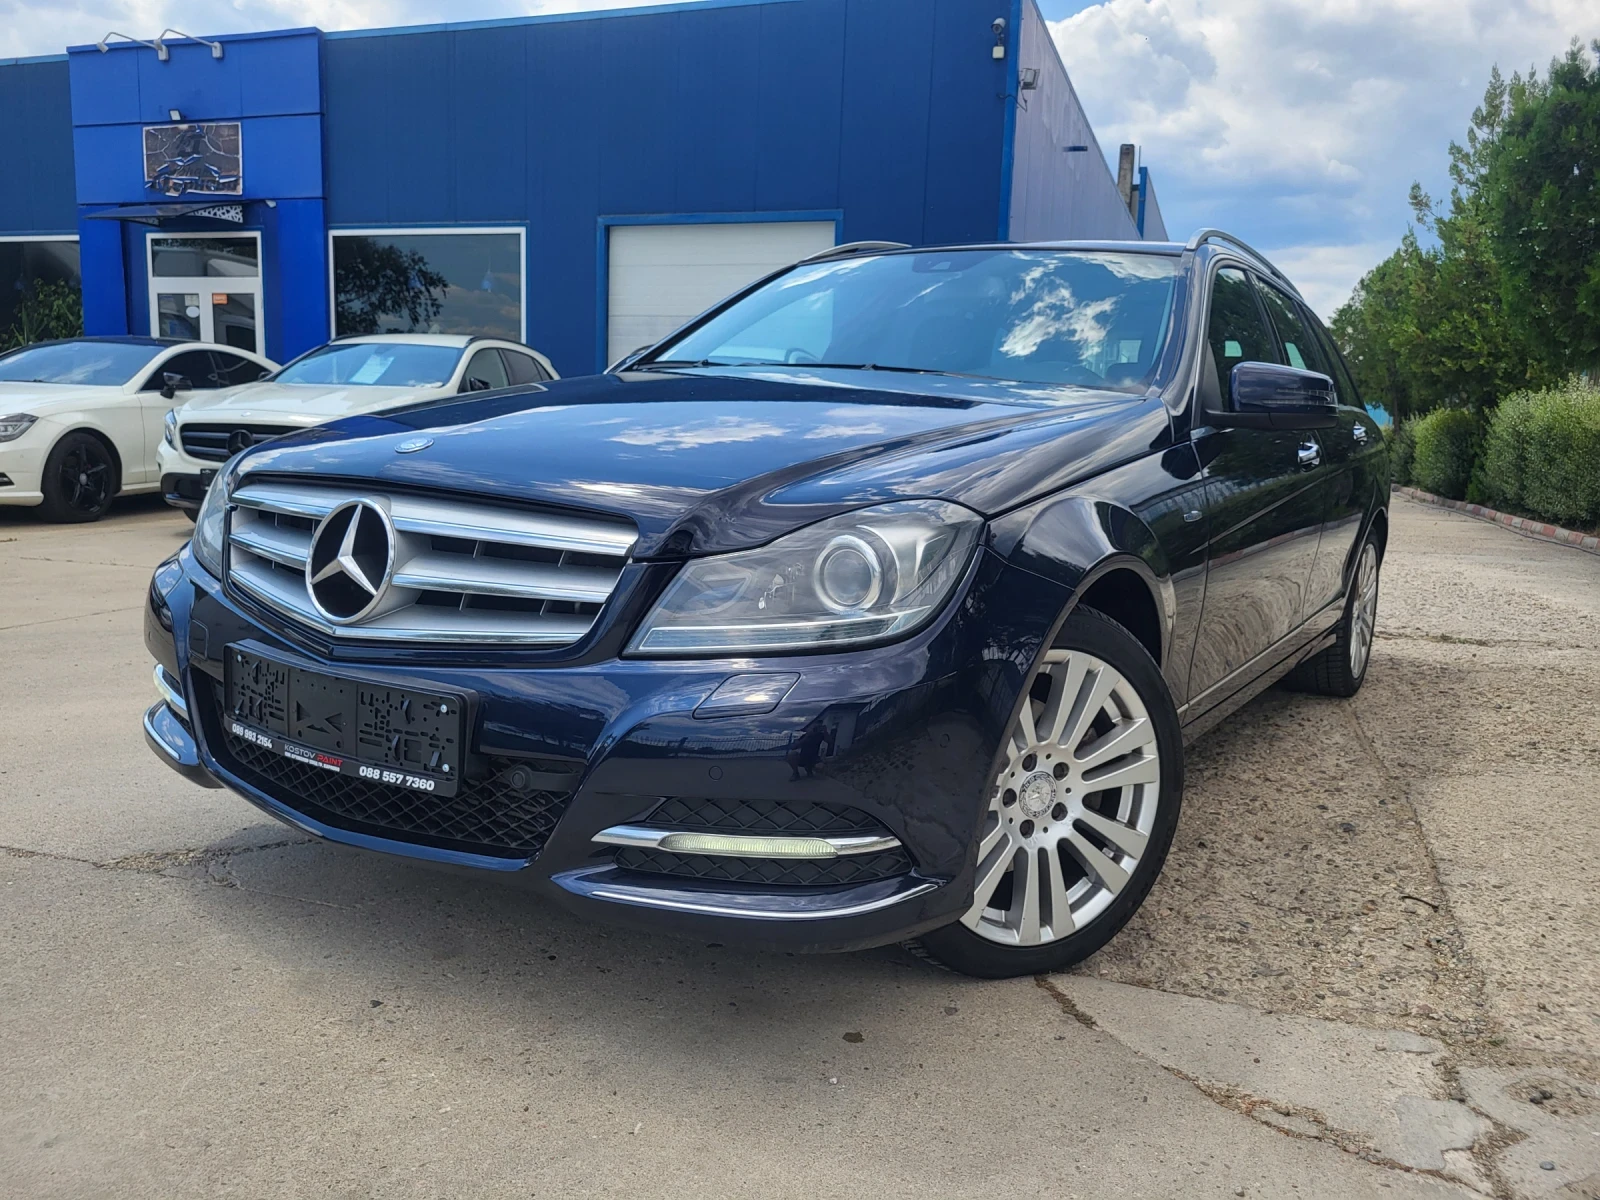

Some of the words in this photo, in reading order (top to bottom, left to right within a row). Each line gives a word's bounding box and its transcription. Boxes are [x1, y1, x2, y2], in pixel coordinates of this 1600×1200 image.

[232, 723, 244, 736] 089
[244, 729, 257, 742] 993
[257, 734, 273, 749] 2154
[284, 743, 316, 759] KOSTOV
[316, 754, 343, 767] PAINT
[359, 766, 380, 780] 088
[382, 771, 404, 785] 557
[405, 776, 435, 791] 7360
